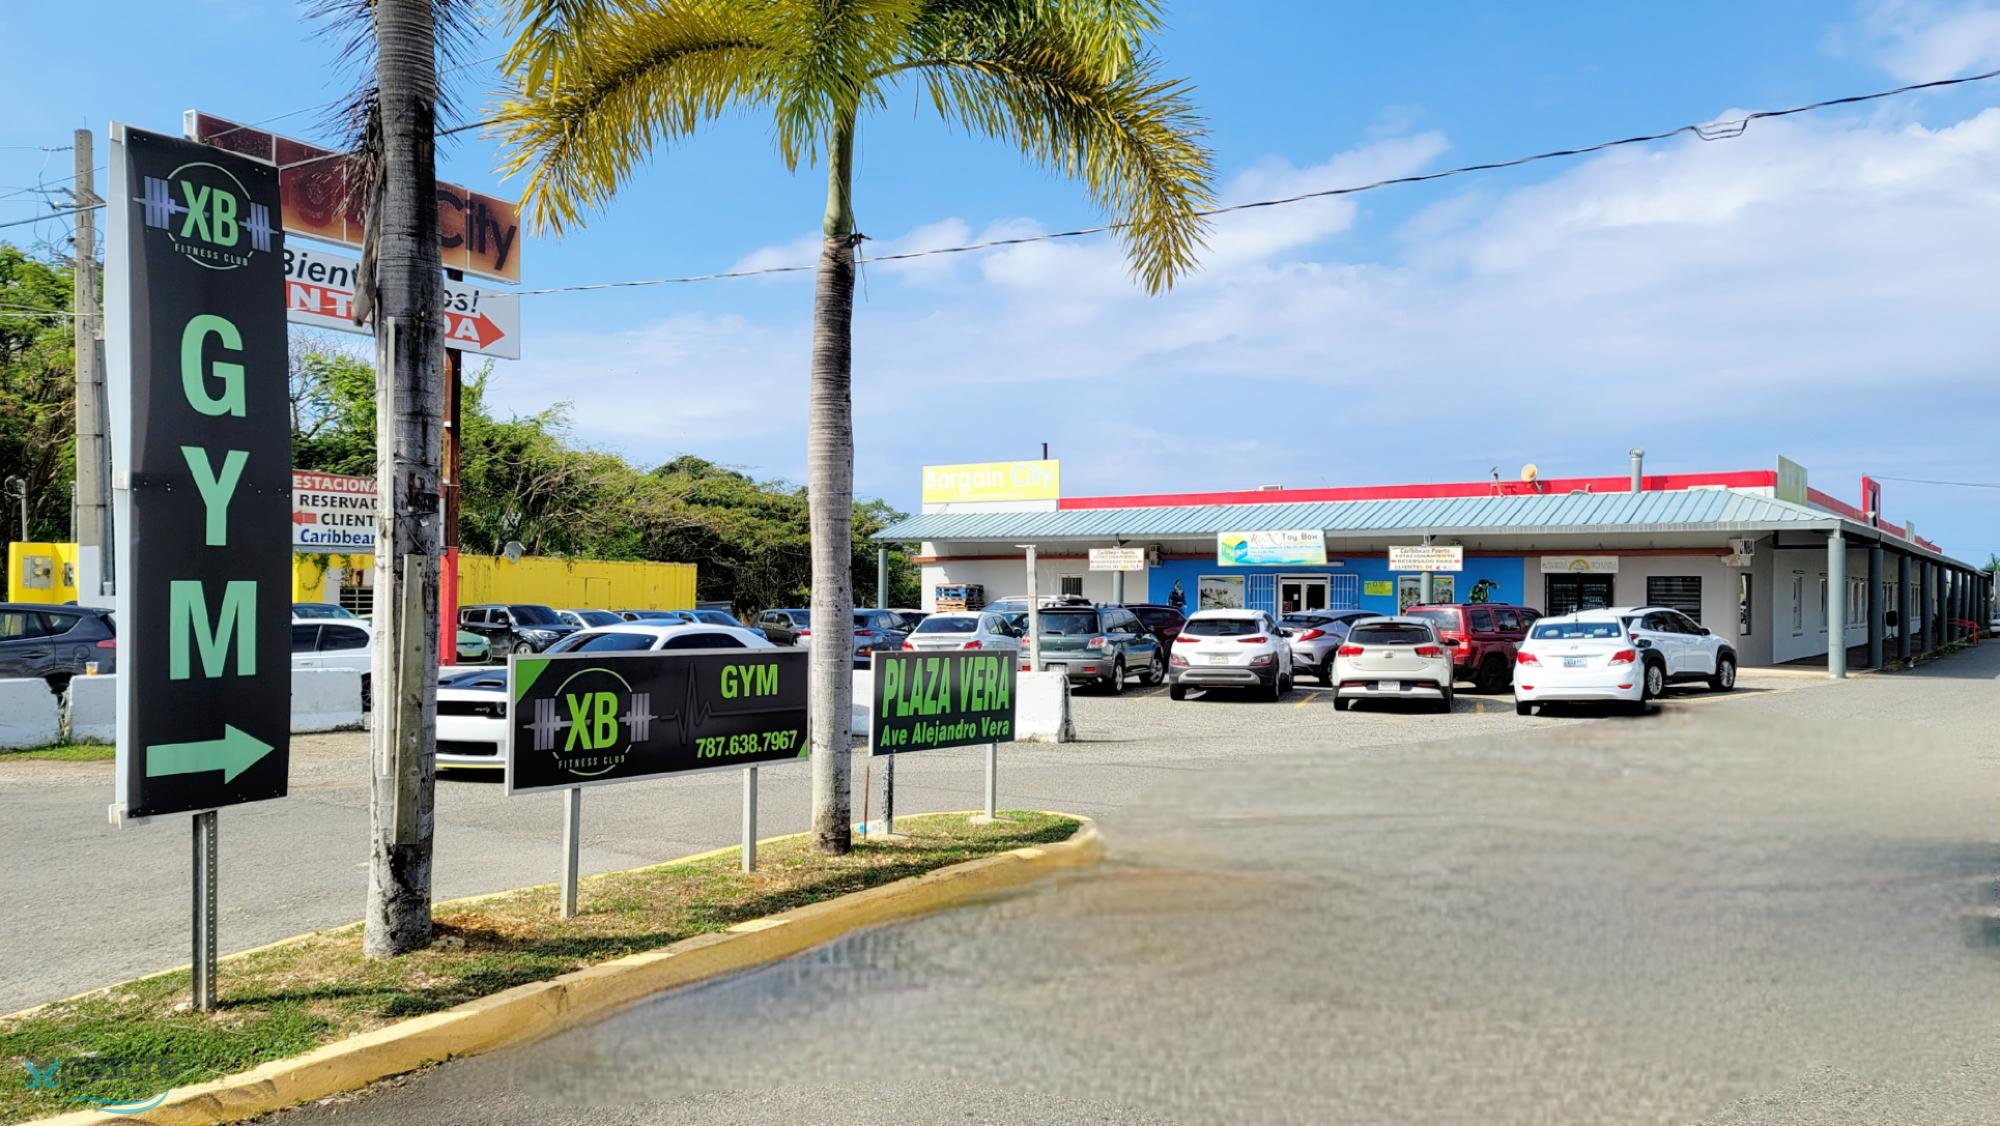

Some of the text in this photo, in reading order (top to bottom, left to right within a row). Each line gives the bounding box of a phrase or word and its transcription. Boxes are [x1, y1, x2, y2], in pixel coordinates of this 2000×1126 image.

[180, 180, 240, 247] XB
[174, 243, 249, 266] FITNESS CLUB
[926, 463, 1055, 492] Bargain City
[720, 664, 779, 699] GYM
[882, 656, 1010, 718] PLAZA VERA
[564, 691, 619, 751] XB
[880, 717, 1010, 747] Ave Alejandro Vera
[695, 729, 799, 759] 787.638.7967
[558, 754, 625, 769] FITNESS CLUB
